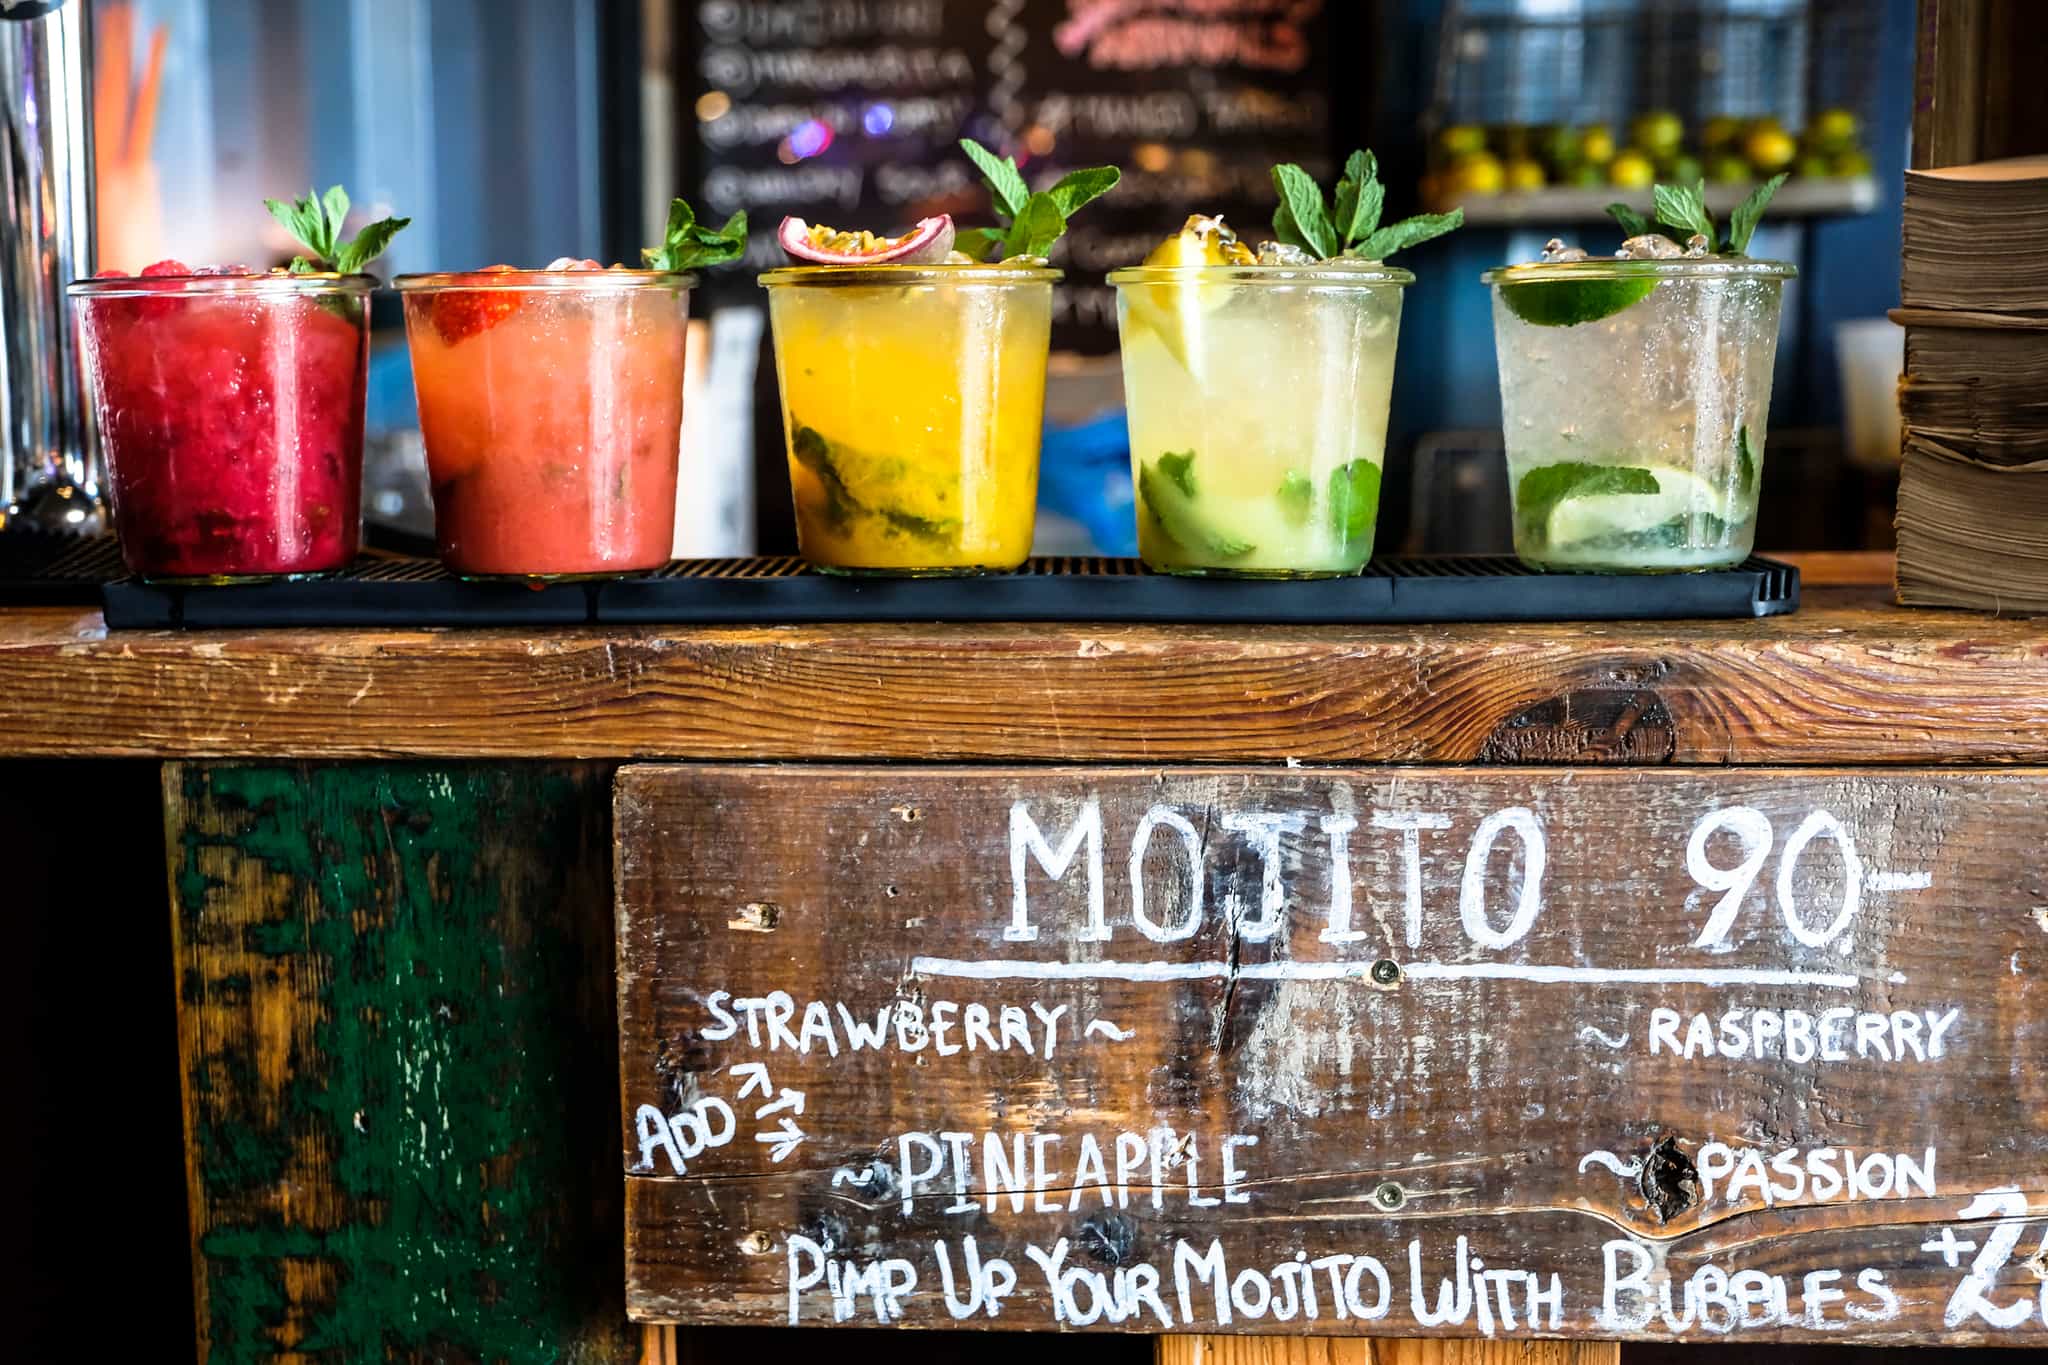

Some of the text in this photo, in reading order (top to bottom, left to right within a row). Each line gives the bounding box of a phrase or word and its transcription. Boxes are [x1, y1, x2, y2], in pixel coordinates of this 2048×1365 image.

[1002, 802, 1547, 949] MOJITO
[700, 990, 1069, 1058] STRAWBERRY
[1648, 1007, 1958, 1064] RASPBERRY
[633, 1097, 736, 1176] ADD
[899, 1131, 1257, 1215] PINEAPPLE
[1697, 1143, 1936, 1201] PASSION
